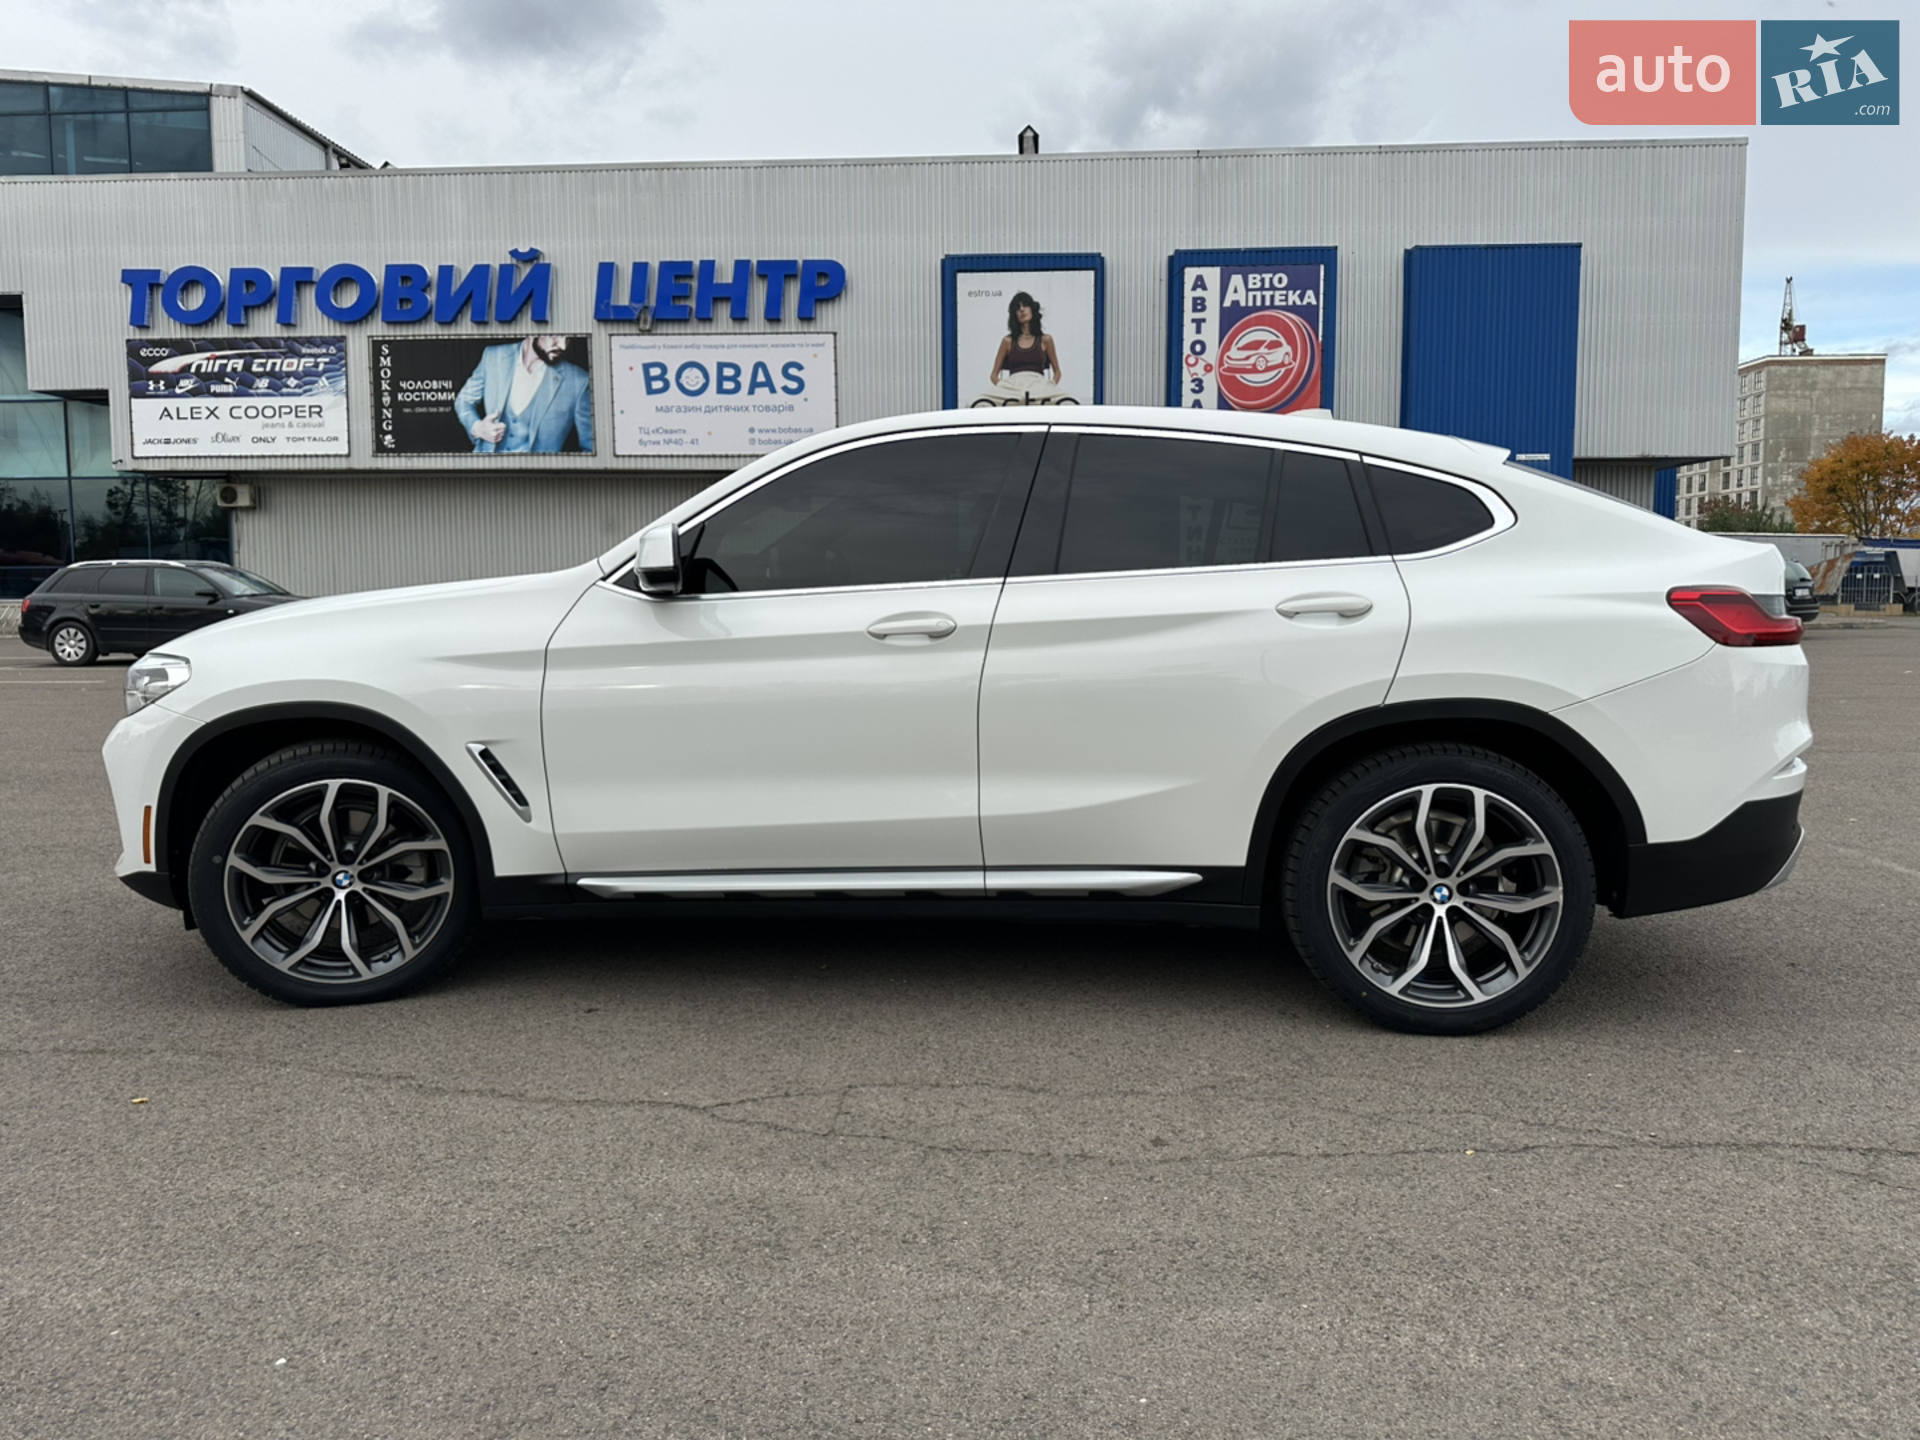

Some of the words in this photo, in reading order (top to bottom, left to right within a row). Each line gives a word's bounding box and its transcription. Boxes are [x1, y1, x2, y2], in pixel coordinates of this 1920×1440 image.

[120, 248, 552, 328] ТОРГОВИЙ
[594, 259, 847, 322] ЦЕНТР
[968, 289, 1003, 298] estro.ua
[641, 360, 806, 397] BOBAS
[210, 384, 234, 393] PUMA
[399, 380, 453, 390] ЧОЛОВІЧІ
[397, 391, 456, 401] КОСТЮМИ
[158, 406, 220, 421] ALEX
[229, 404, 324, 420] COOPER
[655, 405, 701, 414] магазин
[703, 404, 750, 414] дитячих
[751, 402, 795, 414] товарів
[261, 421, 286, 430] jeans
[287, 421, 295, 429] &
[296, 420, 325, 429] casual
[638, 427, 650, 436] ТЦ
[757, 426, 814, 435] www.bobas.ua
[251, 436, 277, 444] ONLY
[638, 438, 662, 447] бутик
[689, 438, 699, 446] 41
